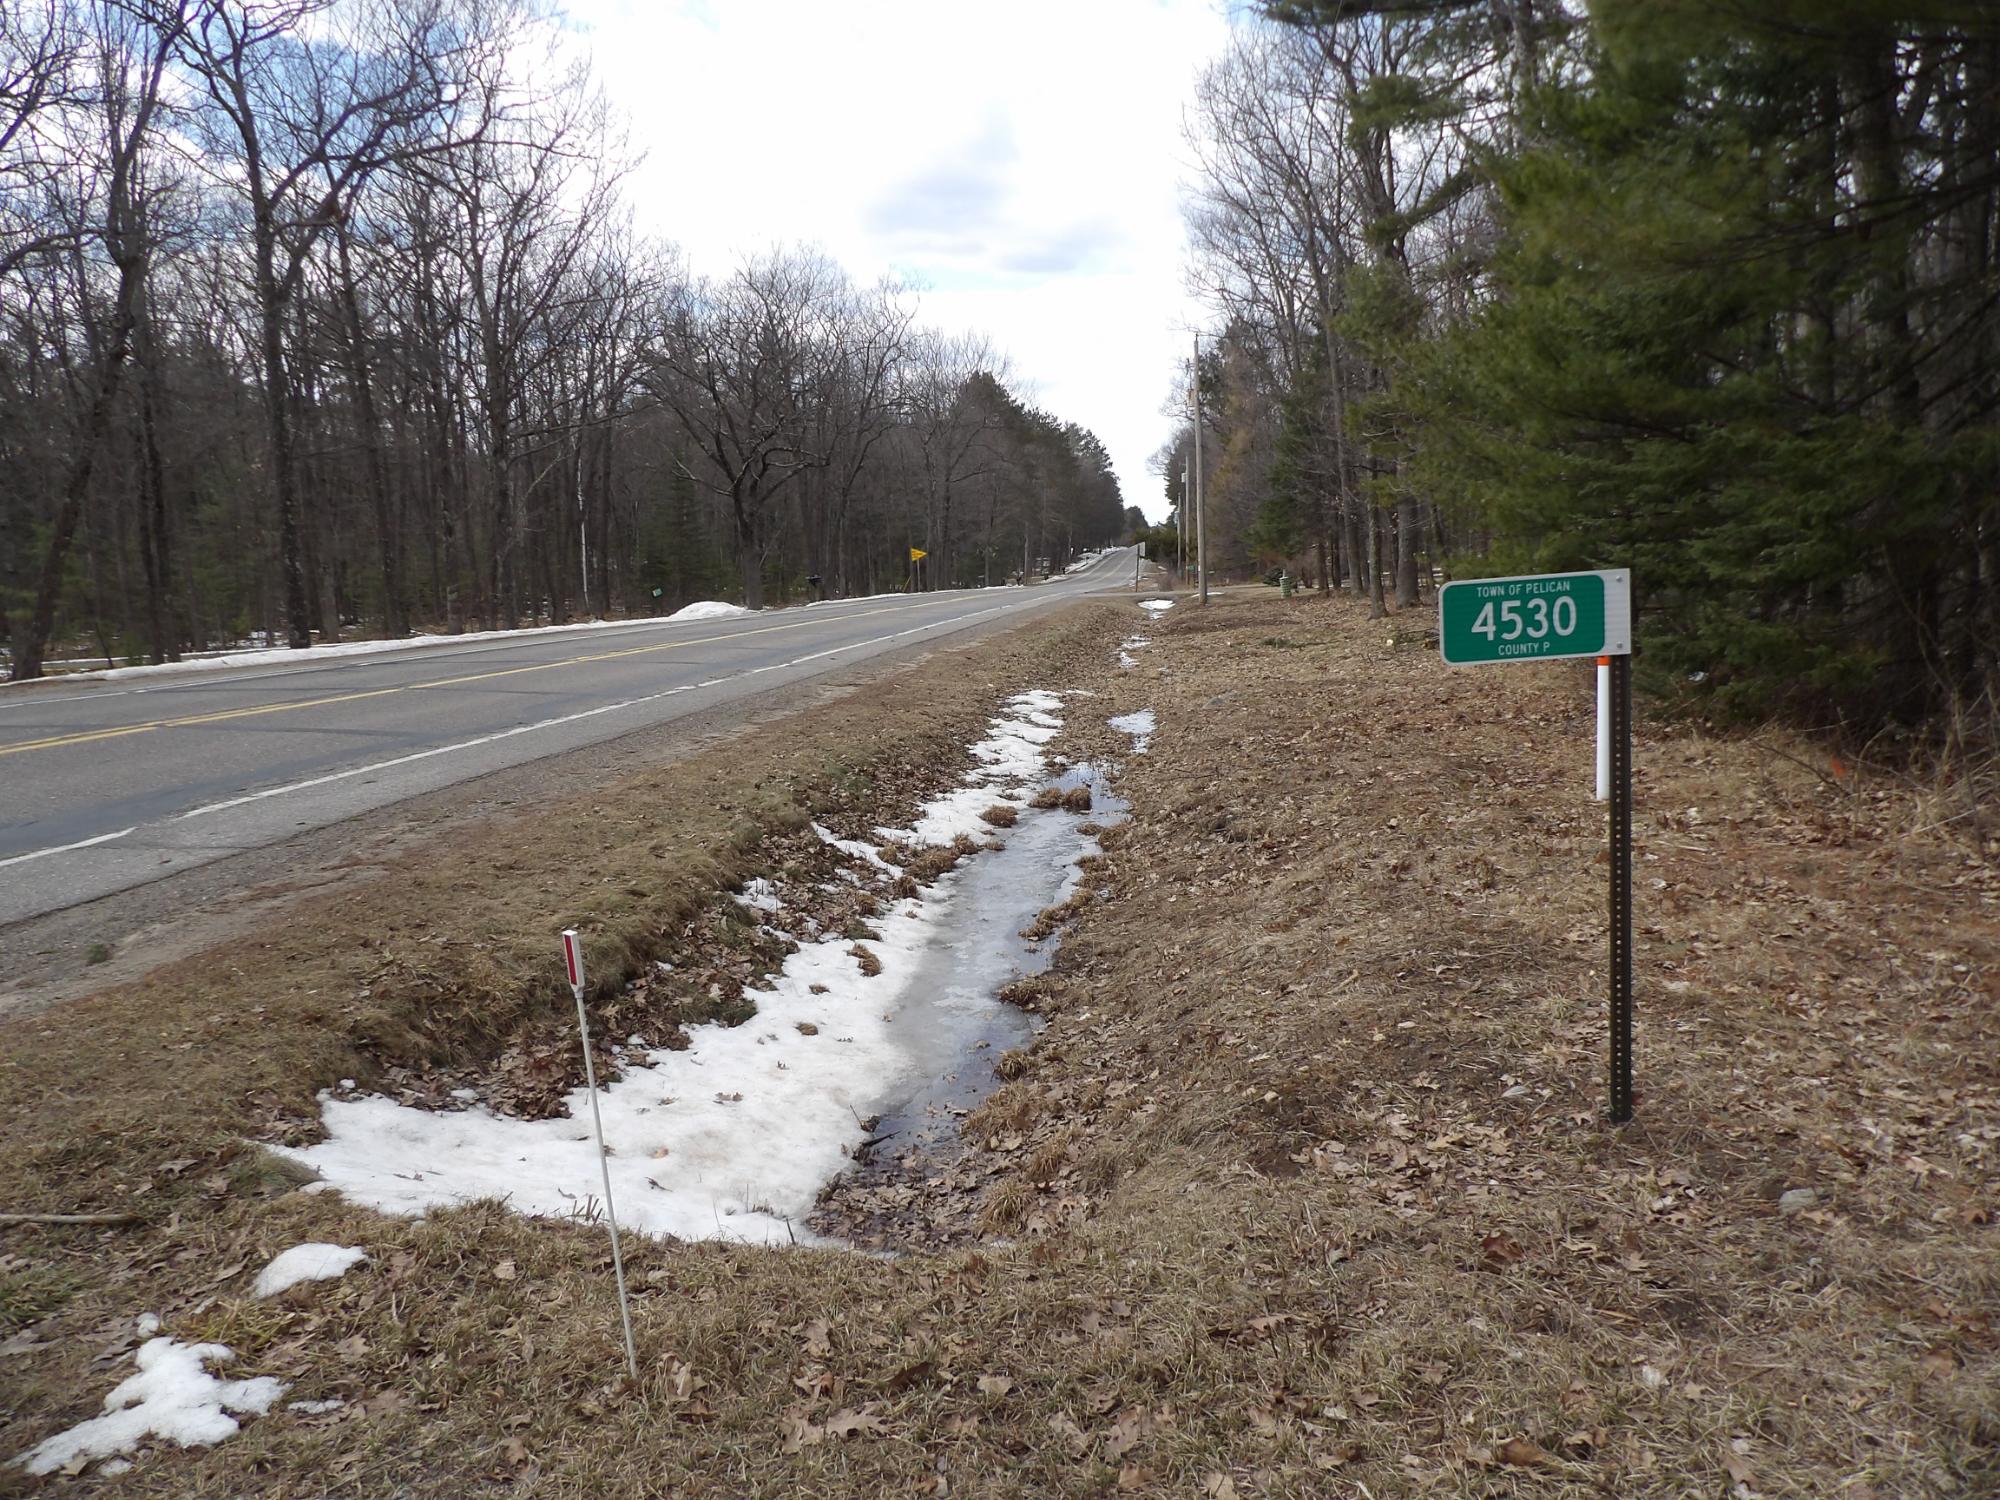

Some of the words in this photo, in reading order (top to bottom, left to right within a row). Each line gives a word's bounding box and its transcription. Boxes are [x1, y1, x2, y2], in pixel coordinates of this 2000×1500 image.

[1477, 586, 1505, 598] TOWN
[1509, 584, 1521, 596] OF
[1526, 581, 1570, 595] PELICAN
[1471, 595, 1577, 641] 4530
[1498, 643, 1539, 656] COUNTY
[1543, 642, 1550, 652] P
